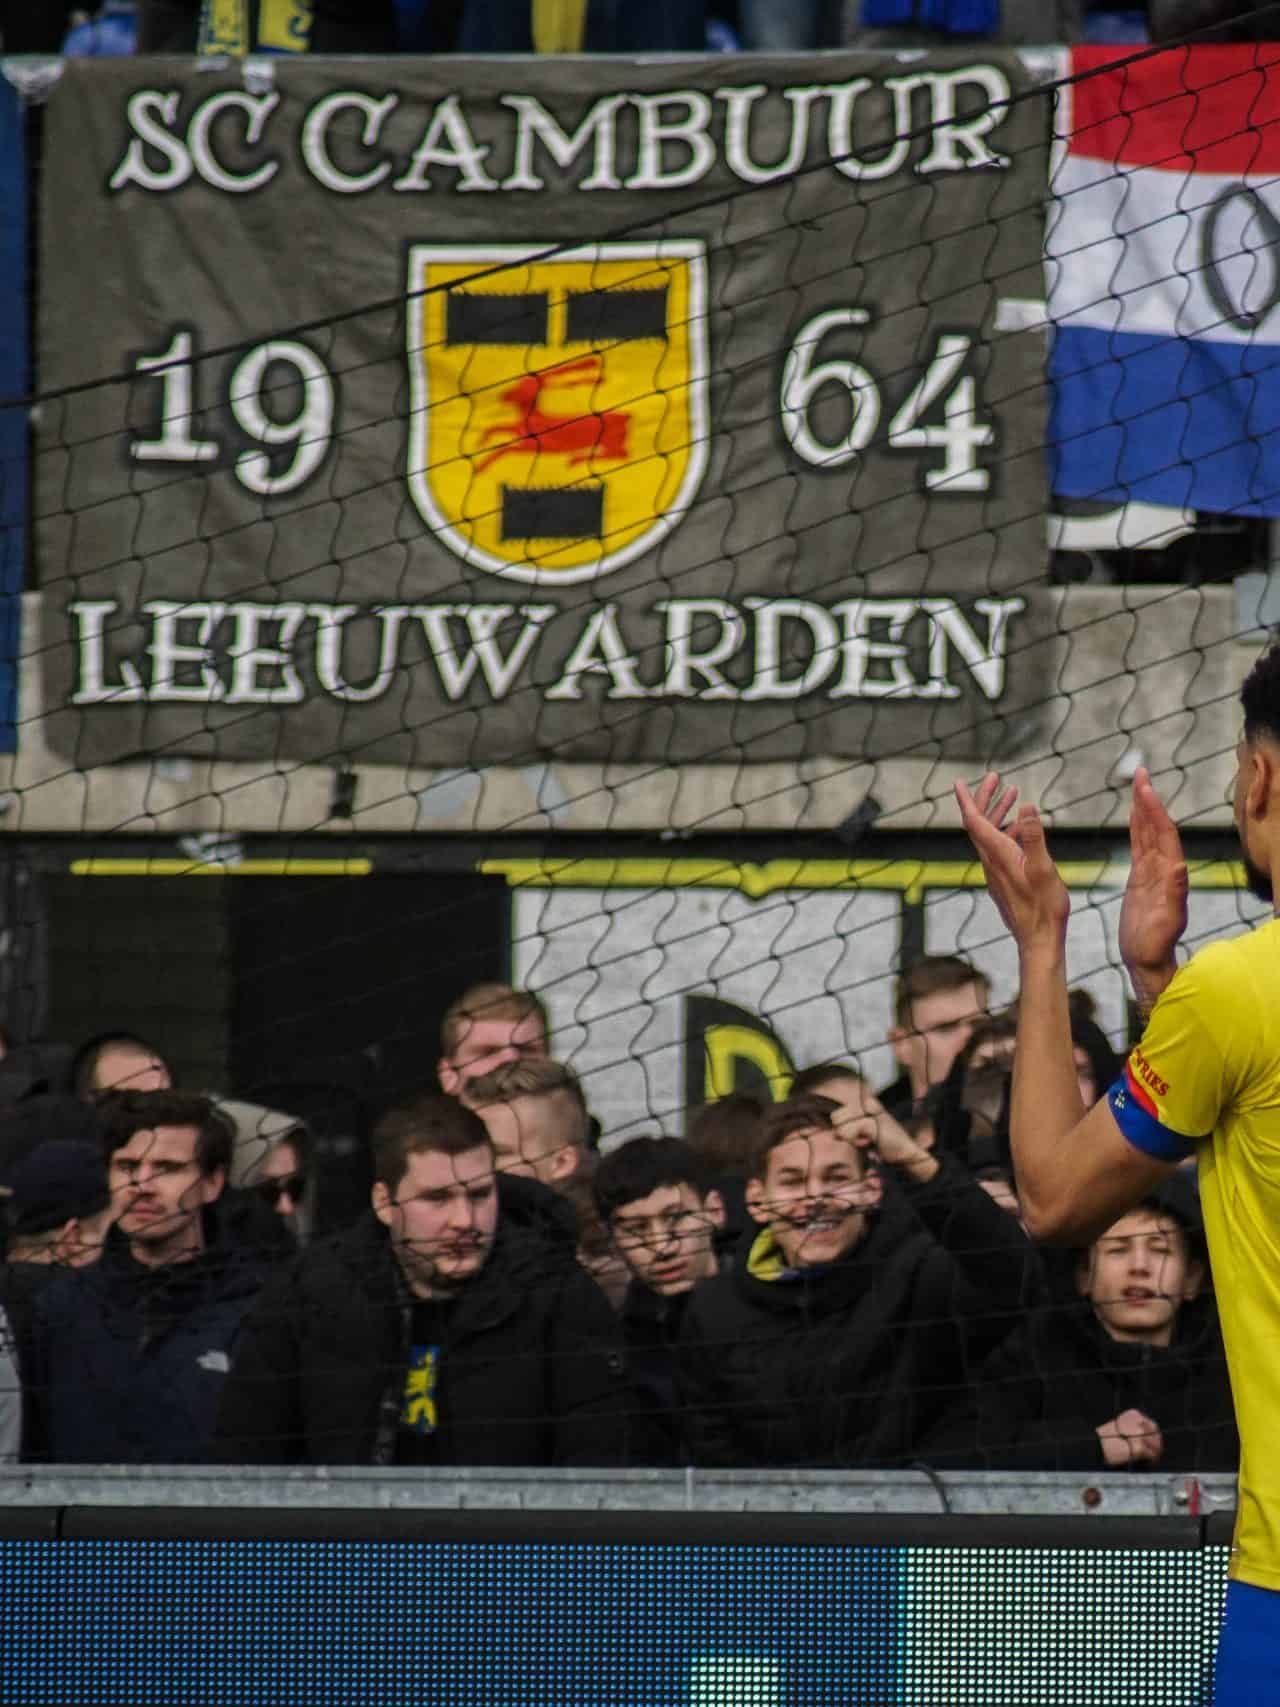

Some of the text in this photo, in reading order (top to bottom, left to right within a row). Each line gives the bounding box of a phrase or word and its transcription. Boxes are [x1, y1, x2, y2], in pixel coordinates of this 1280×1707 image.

[110, 65, 1011, 192] SC CAMBUUR
[130, 308, 994, 494] 19 64
[71, 599, 1025, 704] LEEUWARDEN
